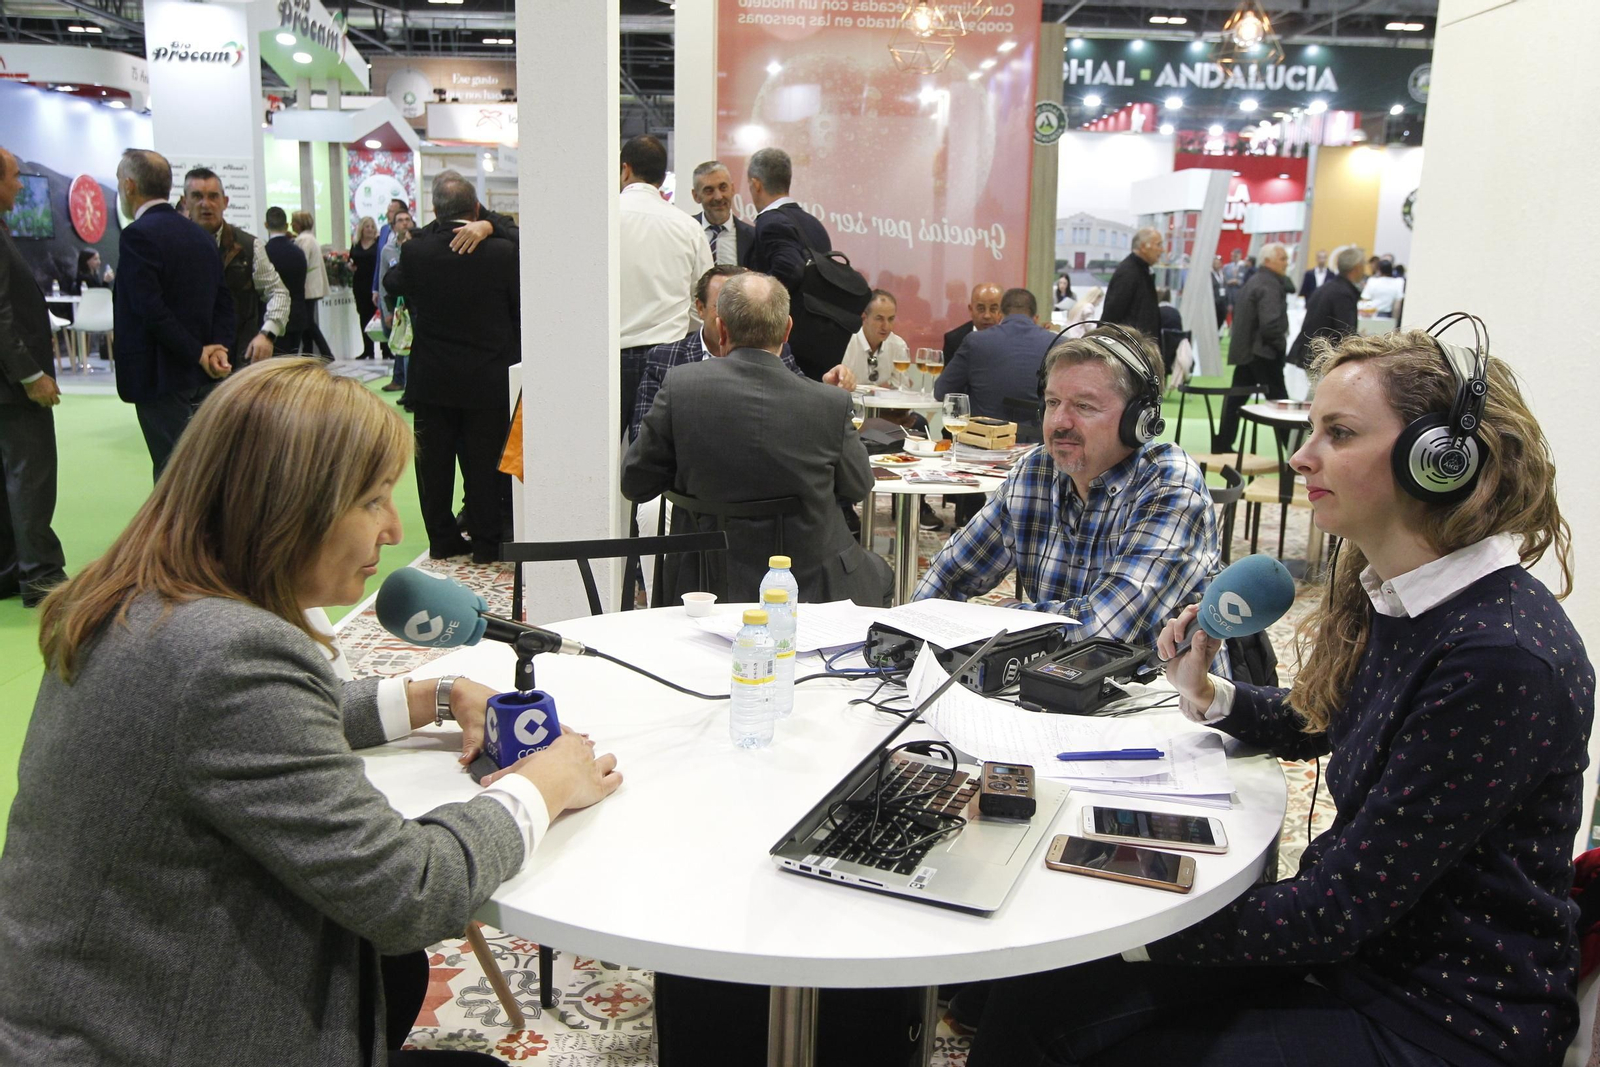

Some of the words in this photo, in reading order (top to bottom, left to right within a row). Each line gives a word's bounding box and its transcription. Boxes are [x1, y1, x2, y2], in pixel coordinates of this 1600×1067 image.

[278, 0, 339, 54] Procam
[152, 47, 230, 63] Procam
[1154, 62, 1339, 92] ANDALUCIA
[1208, 604, 1234, 632] COPE
[433, 620, 460, 647] COPE
